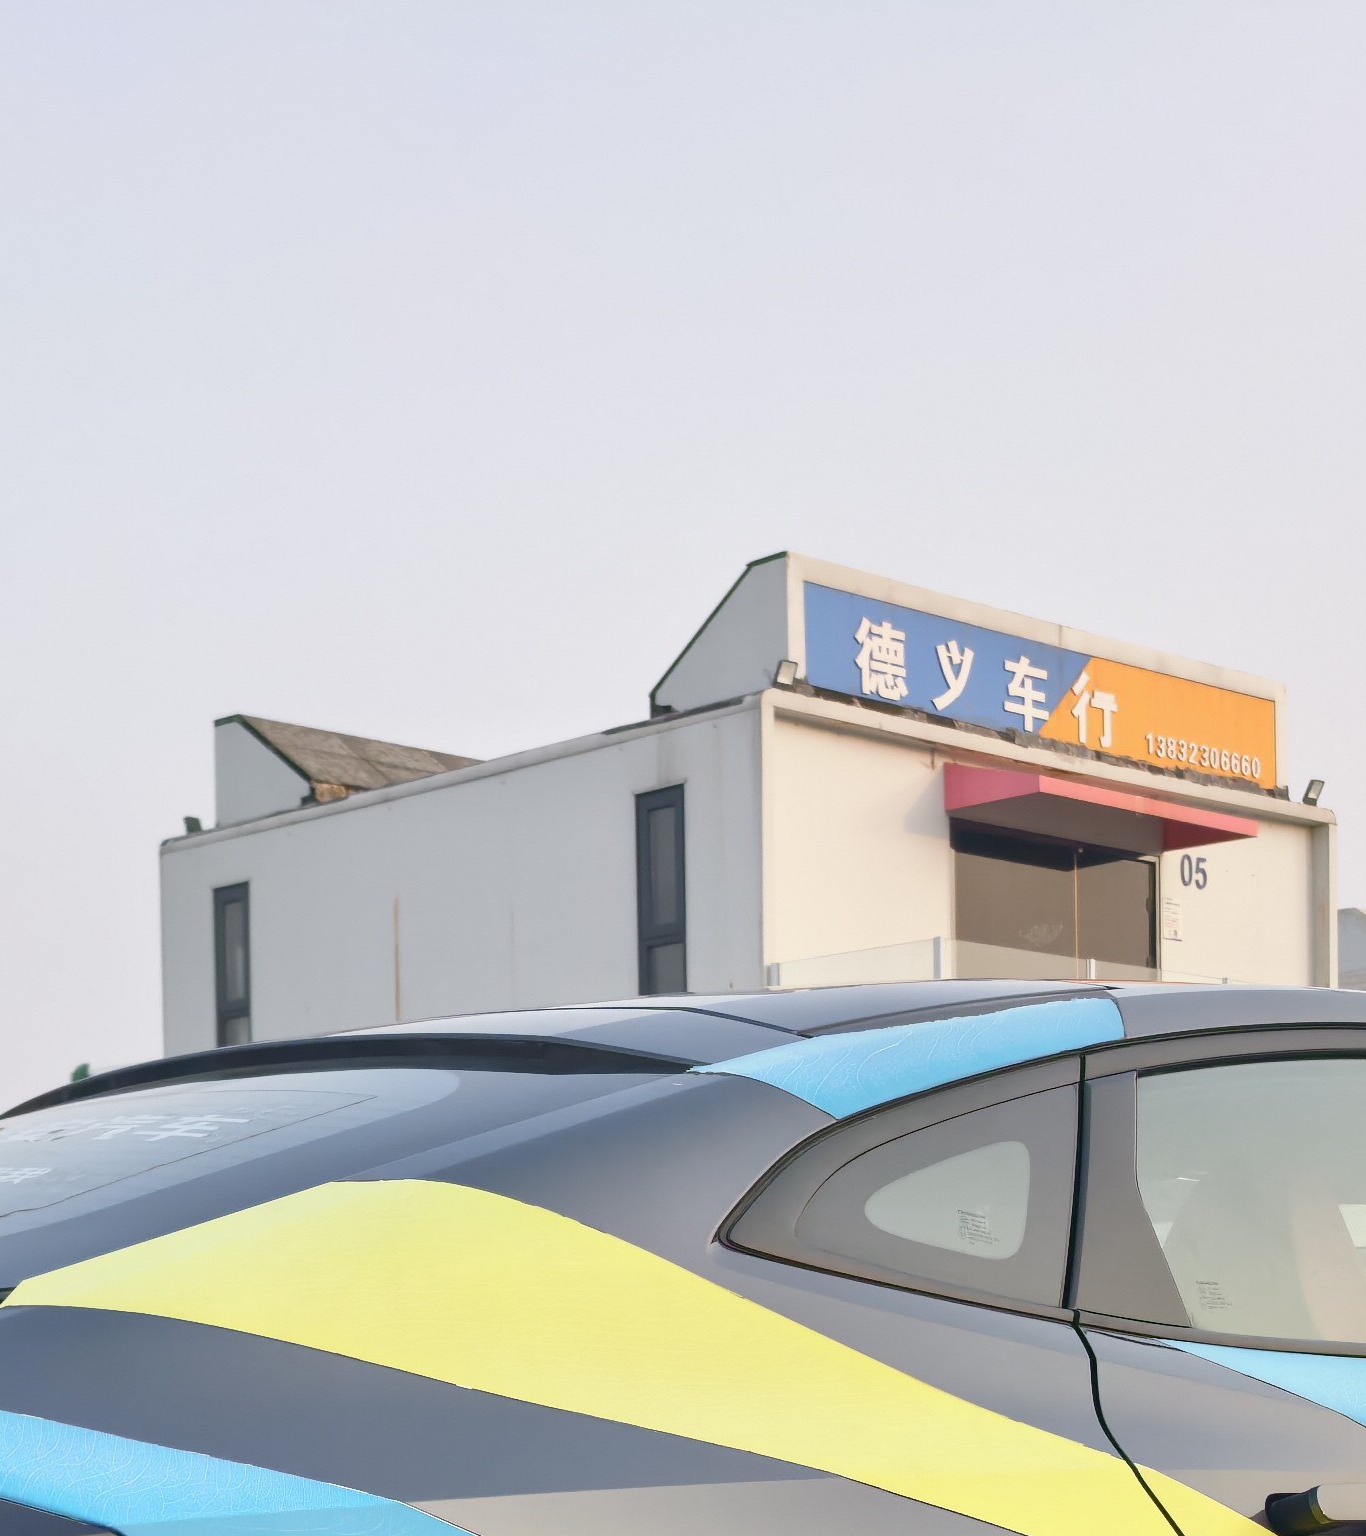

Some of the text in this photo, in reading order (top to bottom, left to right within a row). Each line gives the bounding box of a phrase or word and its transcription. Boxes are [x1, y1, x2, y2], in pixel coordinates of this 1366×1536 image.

[853, 615, 1118, 749] 德义车行
[1145, 732, 1261, 779] 13832306660
[1180, 853, 1208, 891] 05
